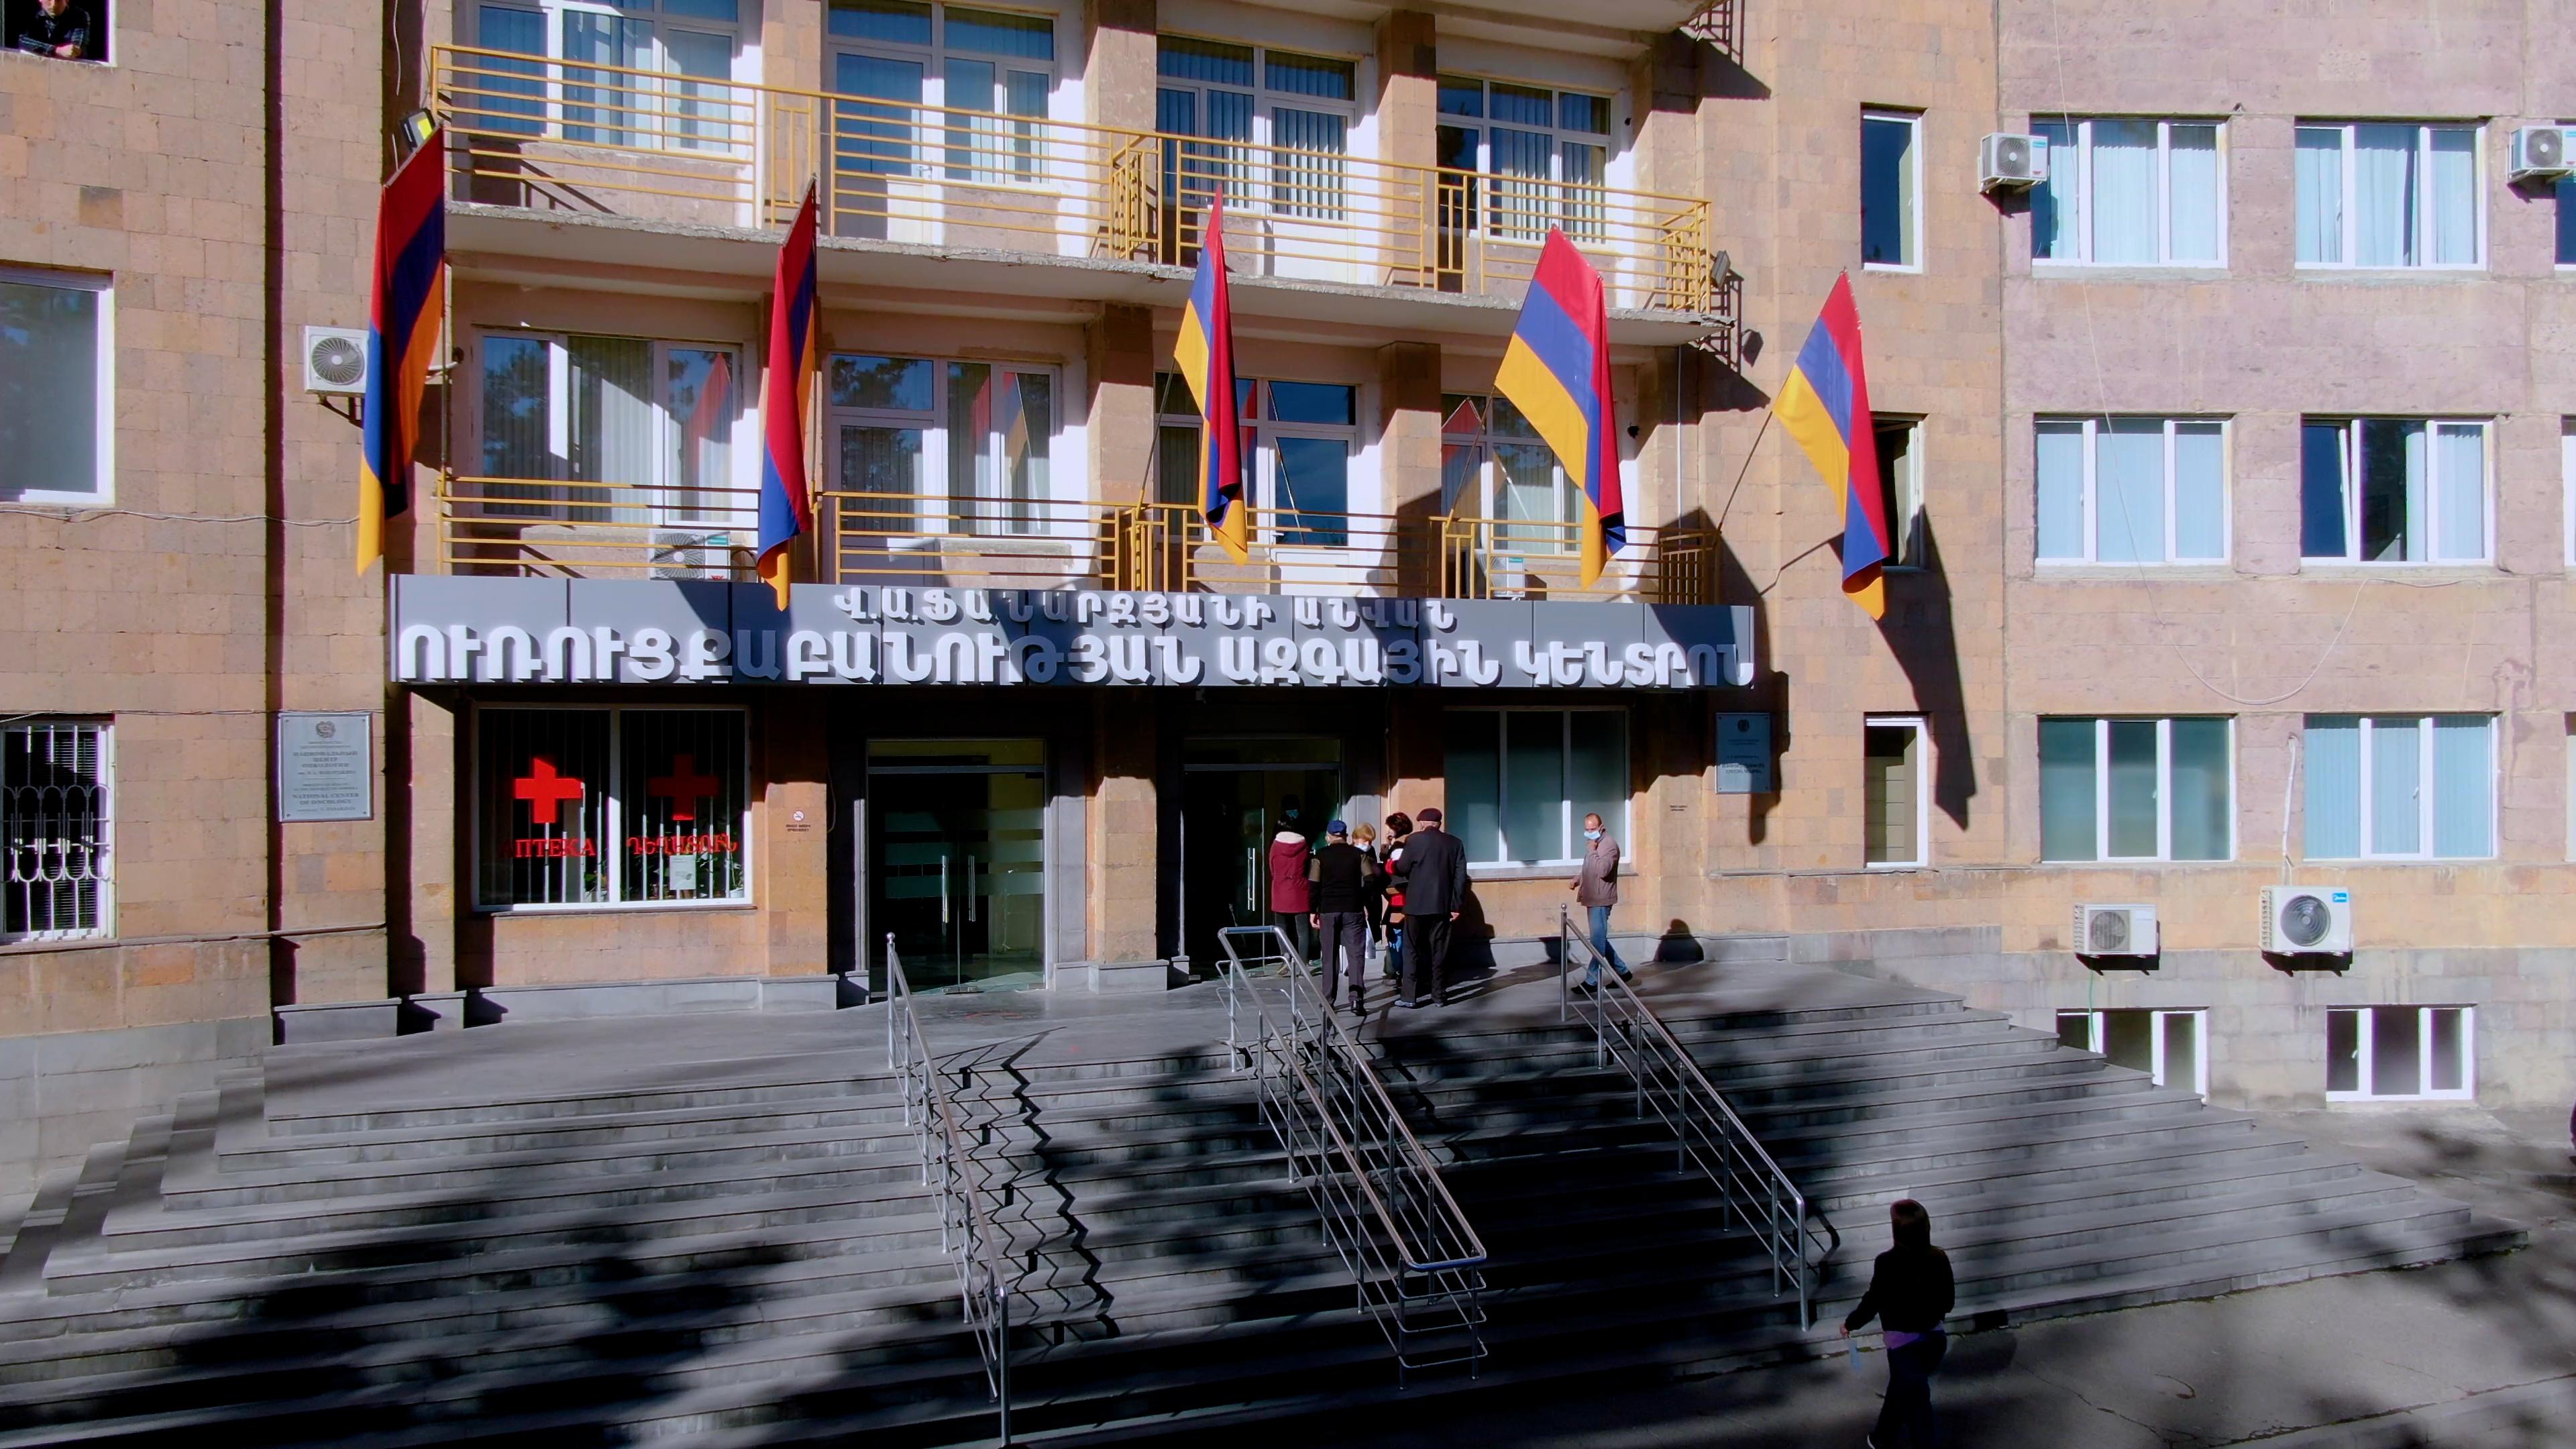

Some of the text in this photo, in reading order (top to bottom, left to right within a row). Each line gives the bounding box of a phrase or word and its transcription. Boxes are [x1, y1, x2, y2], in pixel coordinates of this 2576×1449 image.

[1295, 596, 1454, 629] ԱՆՎԱՆ
[399, 624, 1754, 686] ՈՒՌՈՒՑՔԱԲԱՆՈՒԹՅԱՆ ԱԶԳԱՅԻՆ ԿԵՆՏՐՈՆ
[498, 837, 597, 859] АПТЕКА
